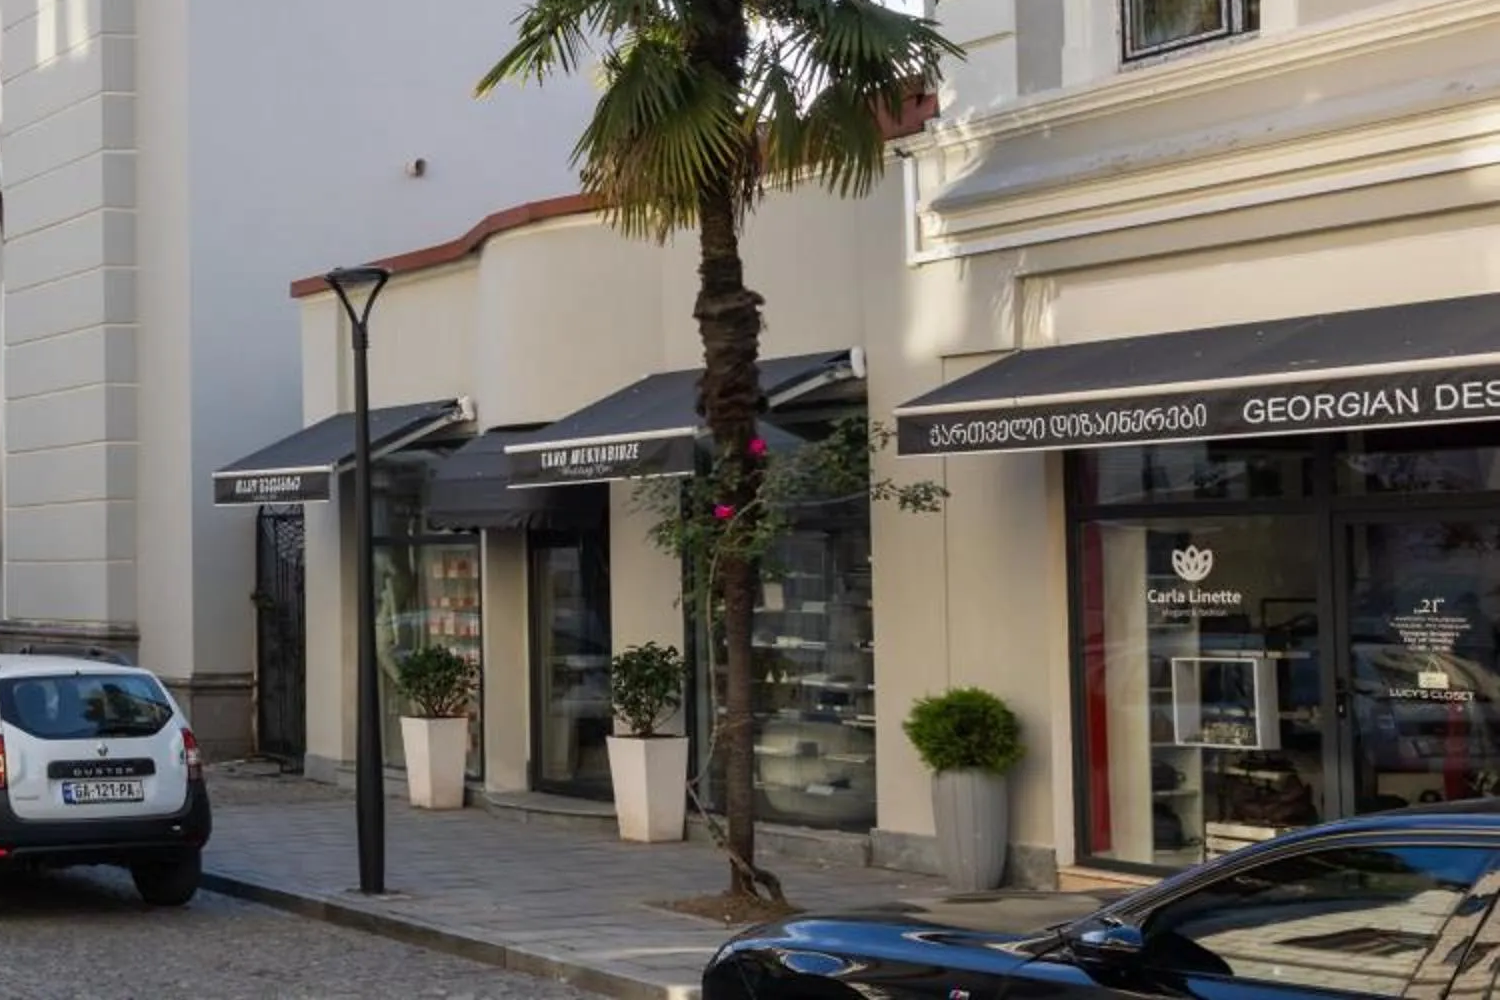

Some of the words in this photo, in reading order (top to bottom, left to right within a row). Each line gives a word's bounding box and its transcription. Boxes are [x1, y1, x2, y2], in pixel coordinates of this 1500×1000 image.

[1242, 387, 1420, 424] GEORGIAN
[1049, 403, 1207, 439] დიზაინერები
[1147, 588, 1185, 603] Carla
[1189, 587, 1242, 605] Linette
[1430, 690, 1475, 703] CLOSET
[73, 767, 135, 777] DUSTER
